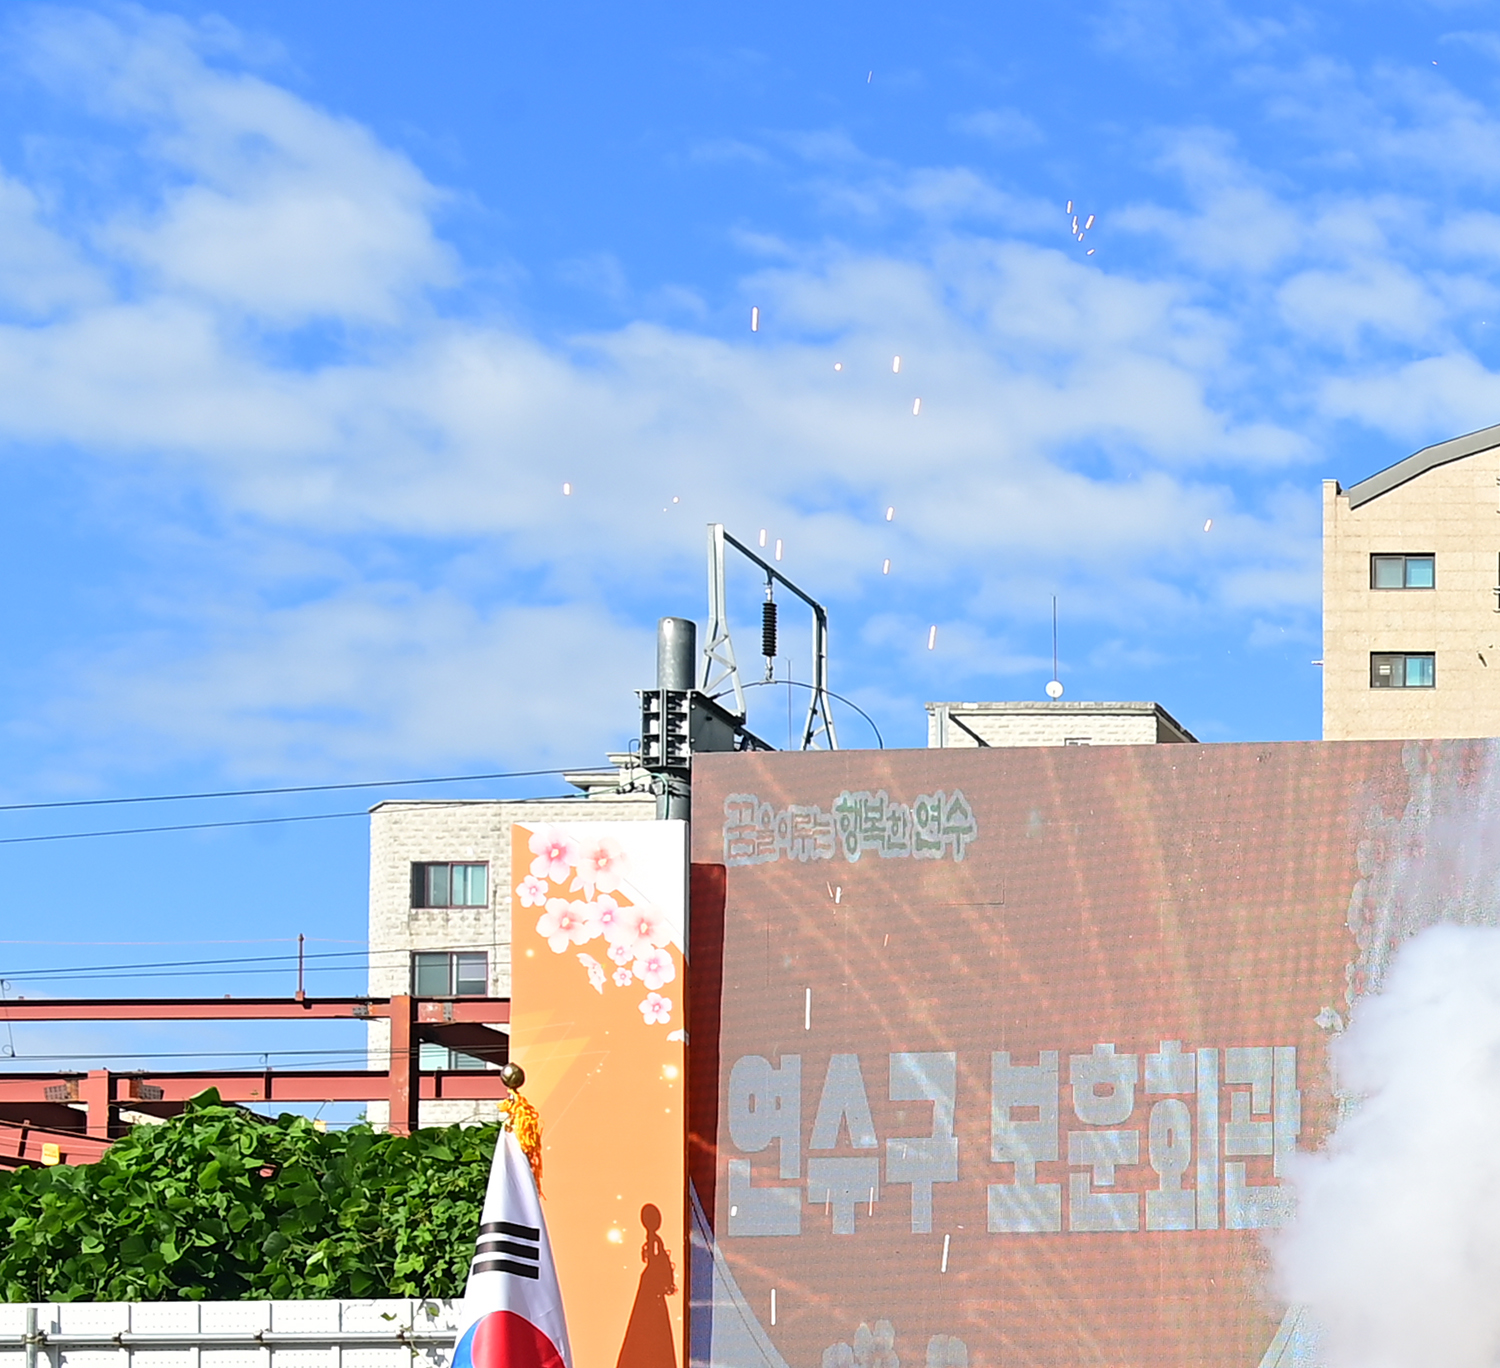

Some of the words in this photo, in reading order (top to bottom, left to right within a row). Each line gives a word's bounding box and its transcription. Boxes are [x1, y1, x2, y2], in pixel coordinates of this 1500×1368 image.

[835, 797, 908, 855] 행복한
[915, 796, 974, 856] 연수
[728, 1052, 959, 1236] 연수구
[986, 1040, 1301, 1233] 보훈회관
